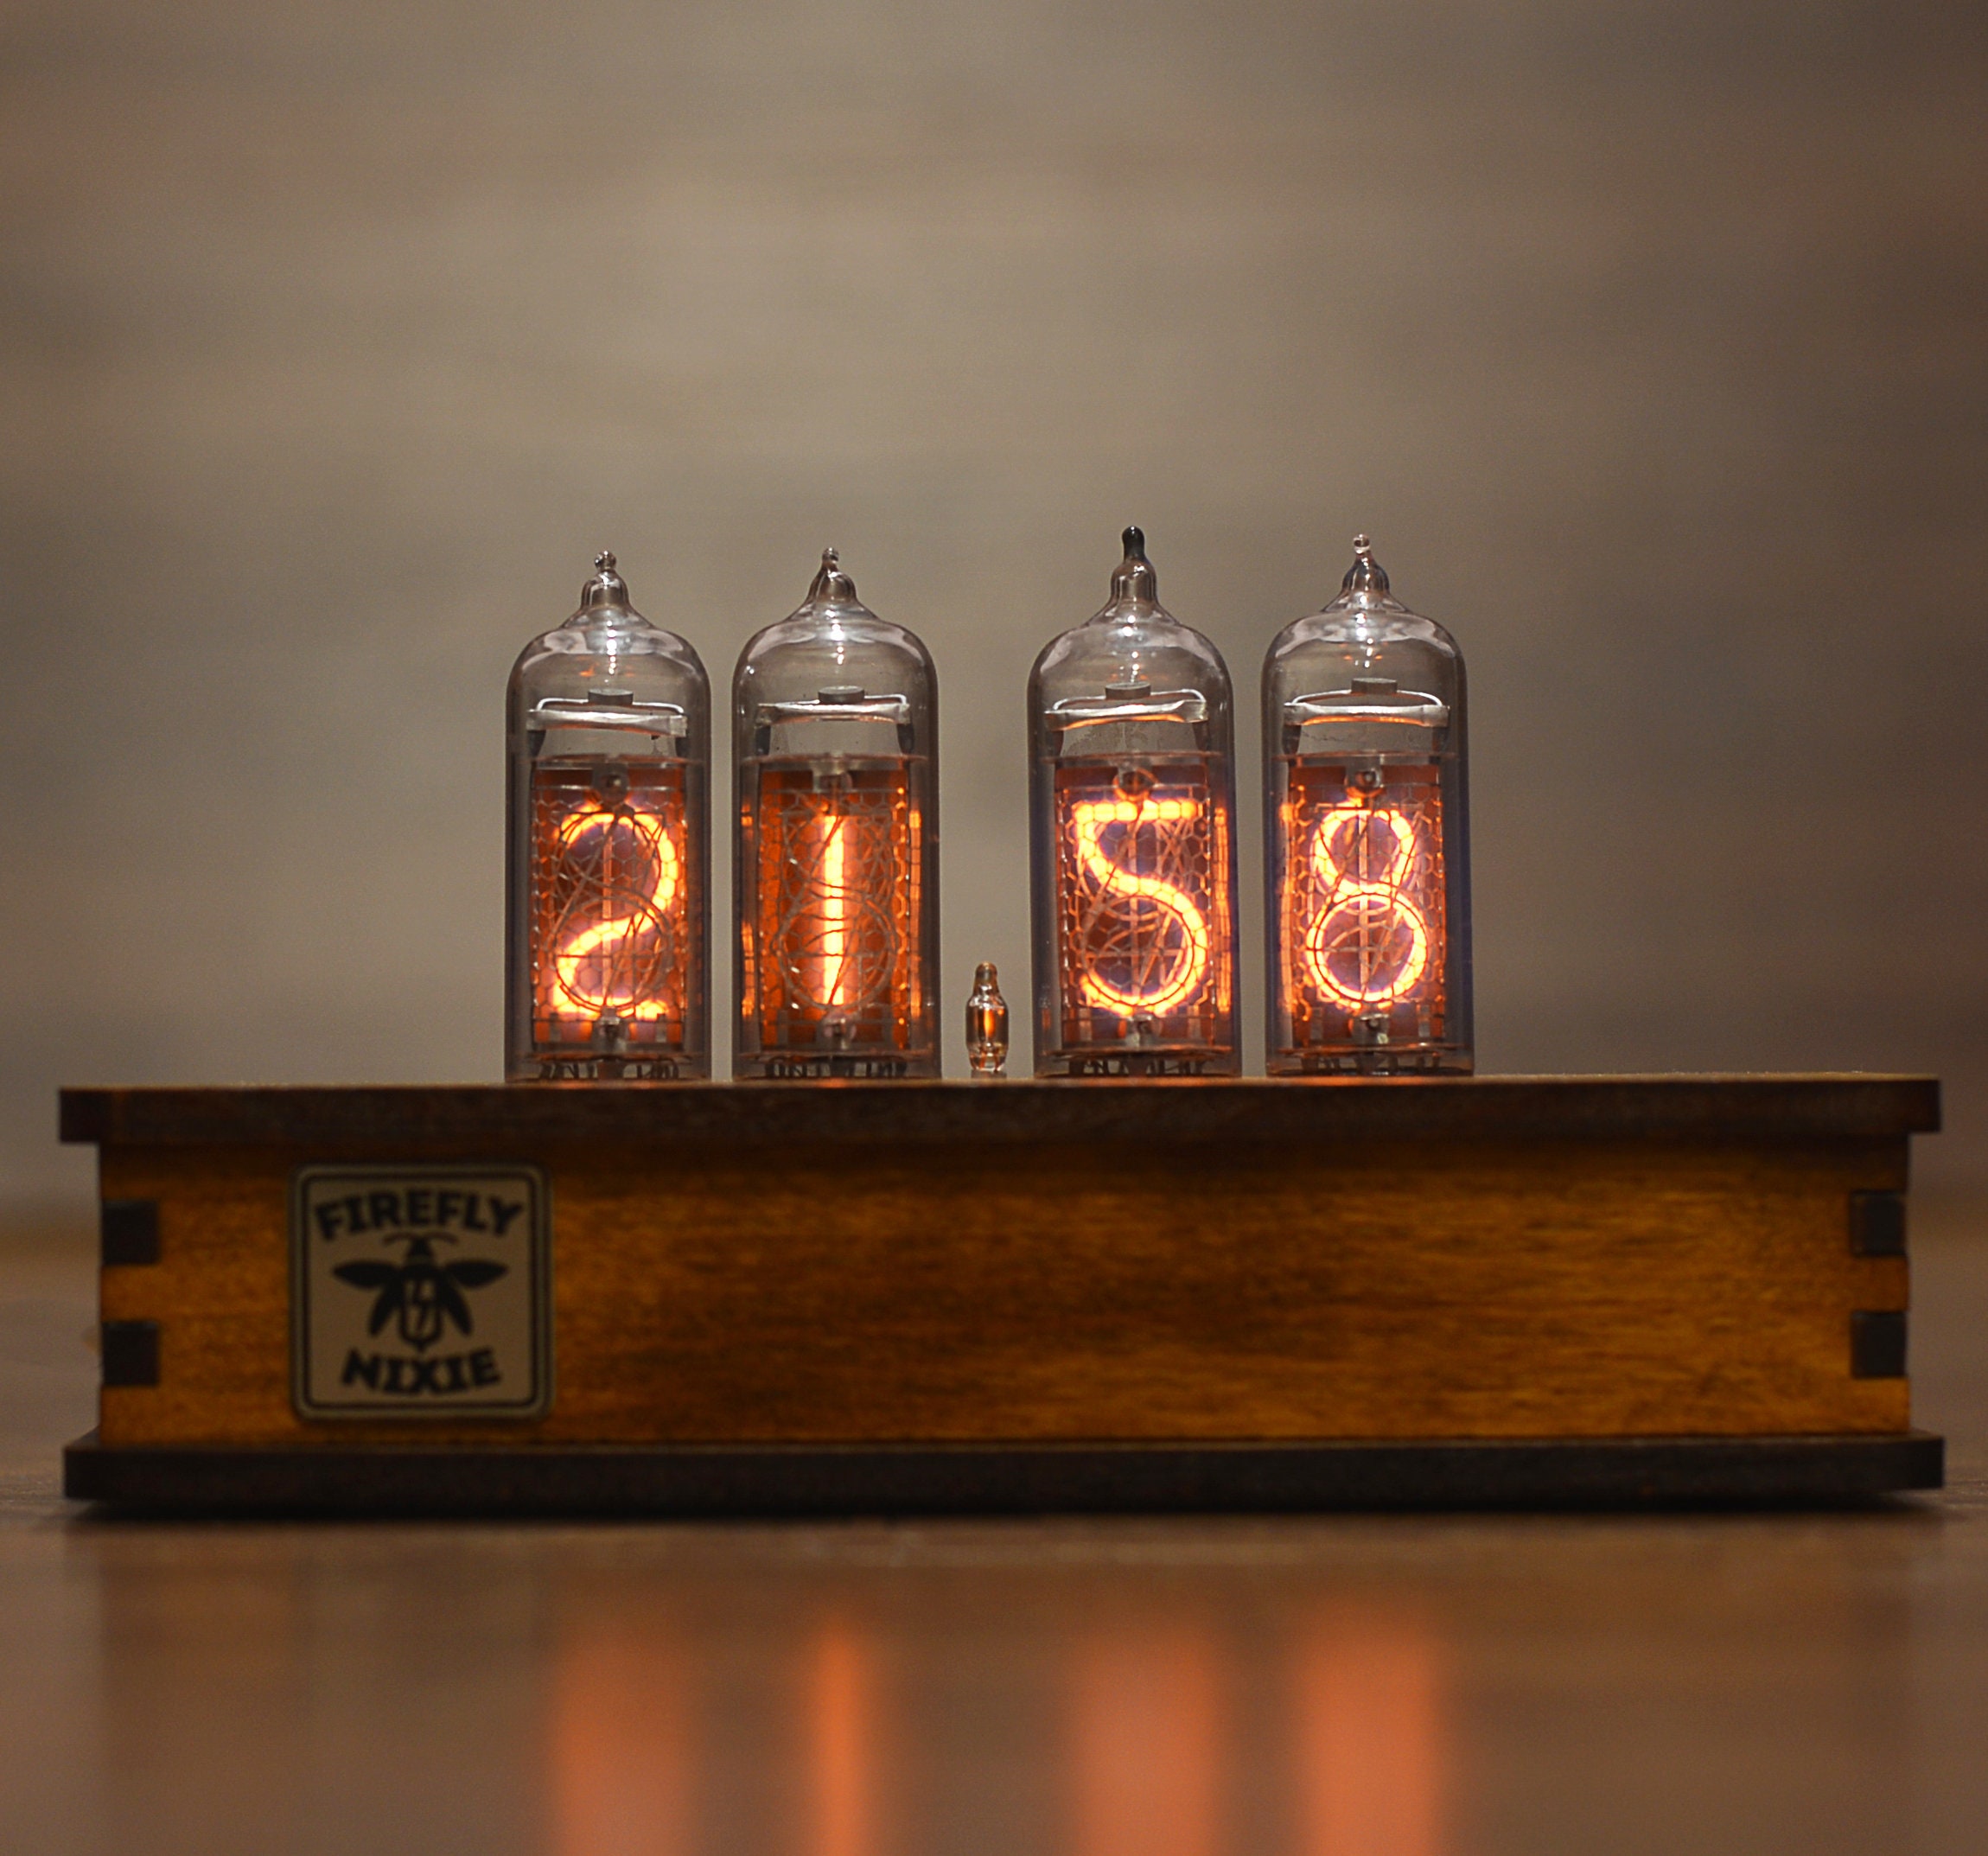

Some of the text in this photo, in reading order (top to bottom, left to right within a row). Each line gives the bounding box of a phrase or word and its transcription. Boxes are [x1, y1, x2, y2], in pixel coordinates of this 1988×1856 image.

[552, 800, 1429, 1020] 2 1 5 8
[315, 1189, 523, 1242] FIREFLY
[341, 1346, 502, 1395] NIXIE
